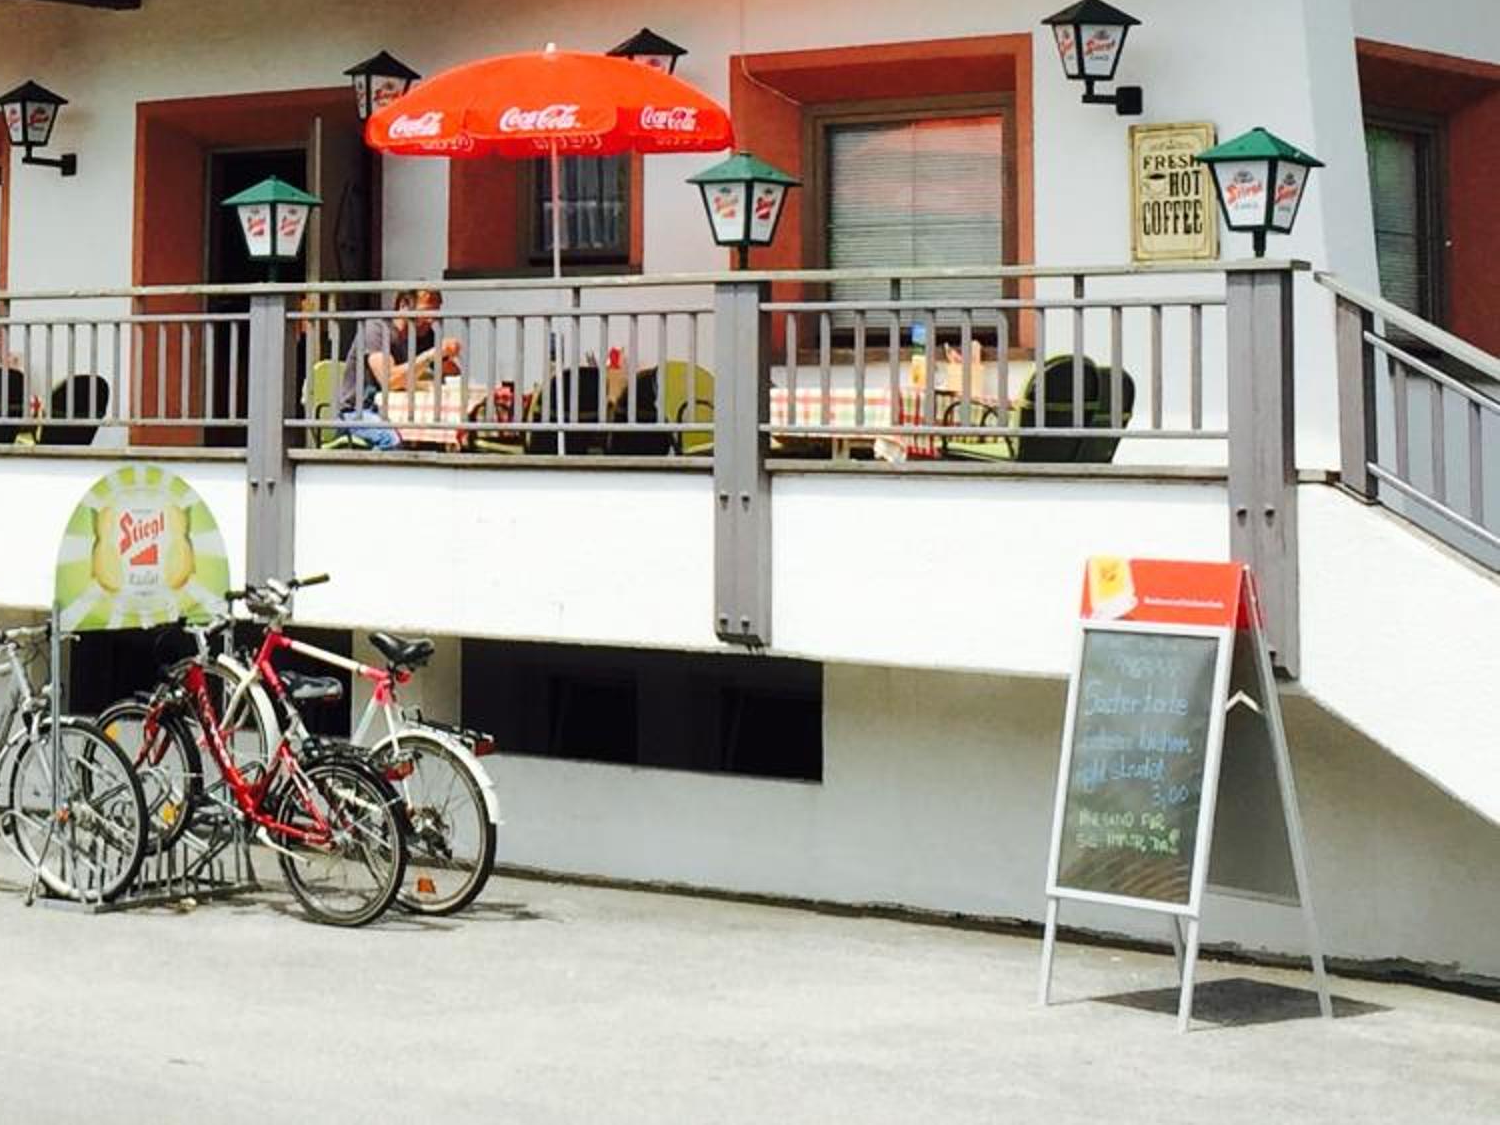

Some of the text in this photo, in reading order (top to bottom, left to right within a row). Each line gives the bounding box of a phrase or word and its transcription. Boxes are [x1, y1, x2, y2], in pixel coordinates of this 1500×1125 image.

[1143, 154, 1203, 170] FRESH
[1169, 170, 1201, 196] HOT
[1143, 199, 1203, 235] COFFEE
[119, 511, 164, 555] Stiegl
